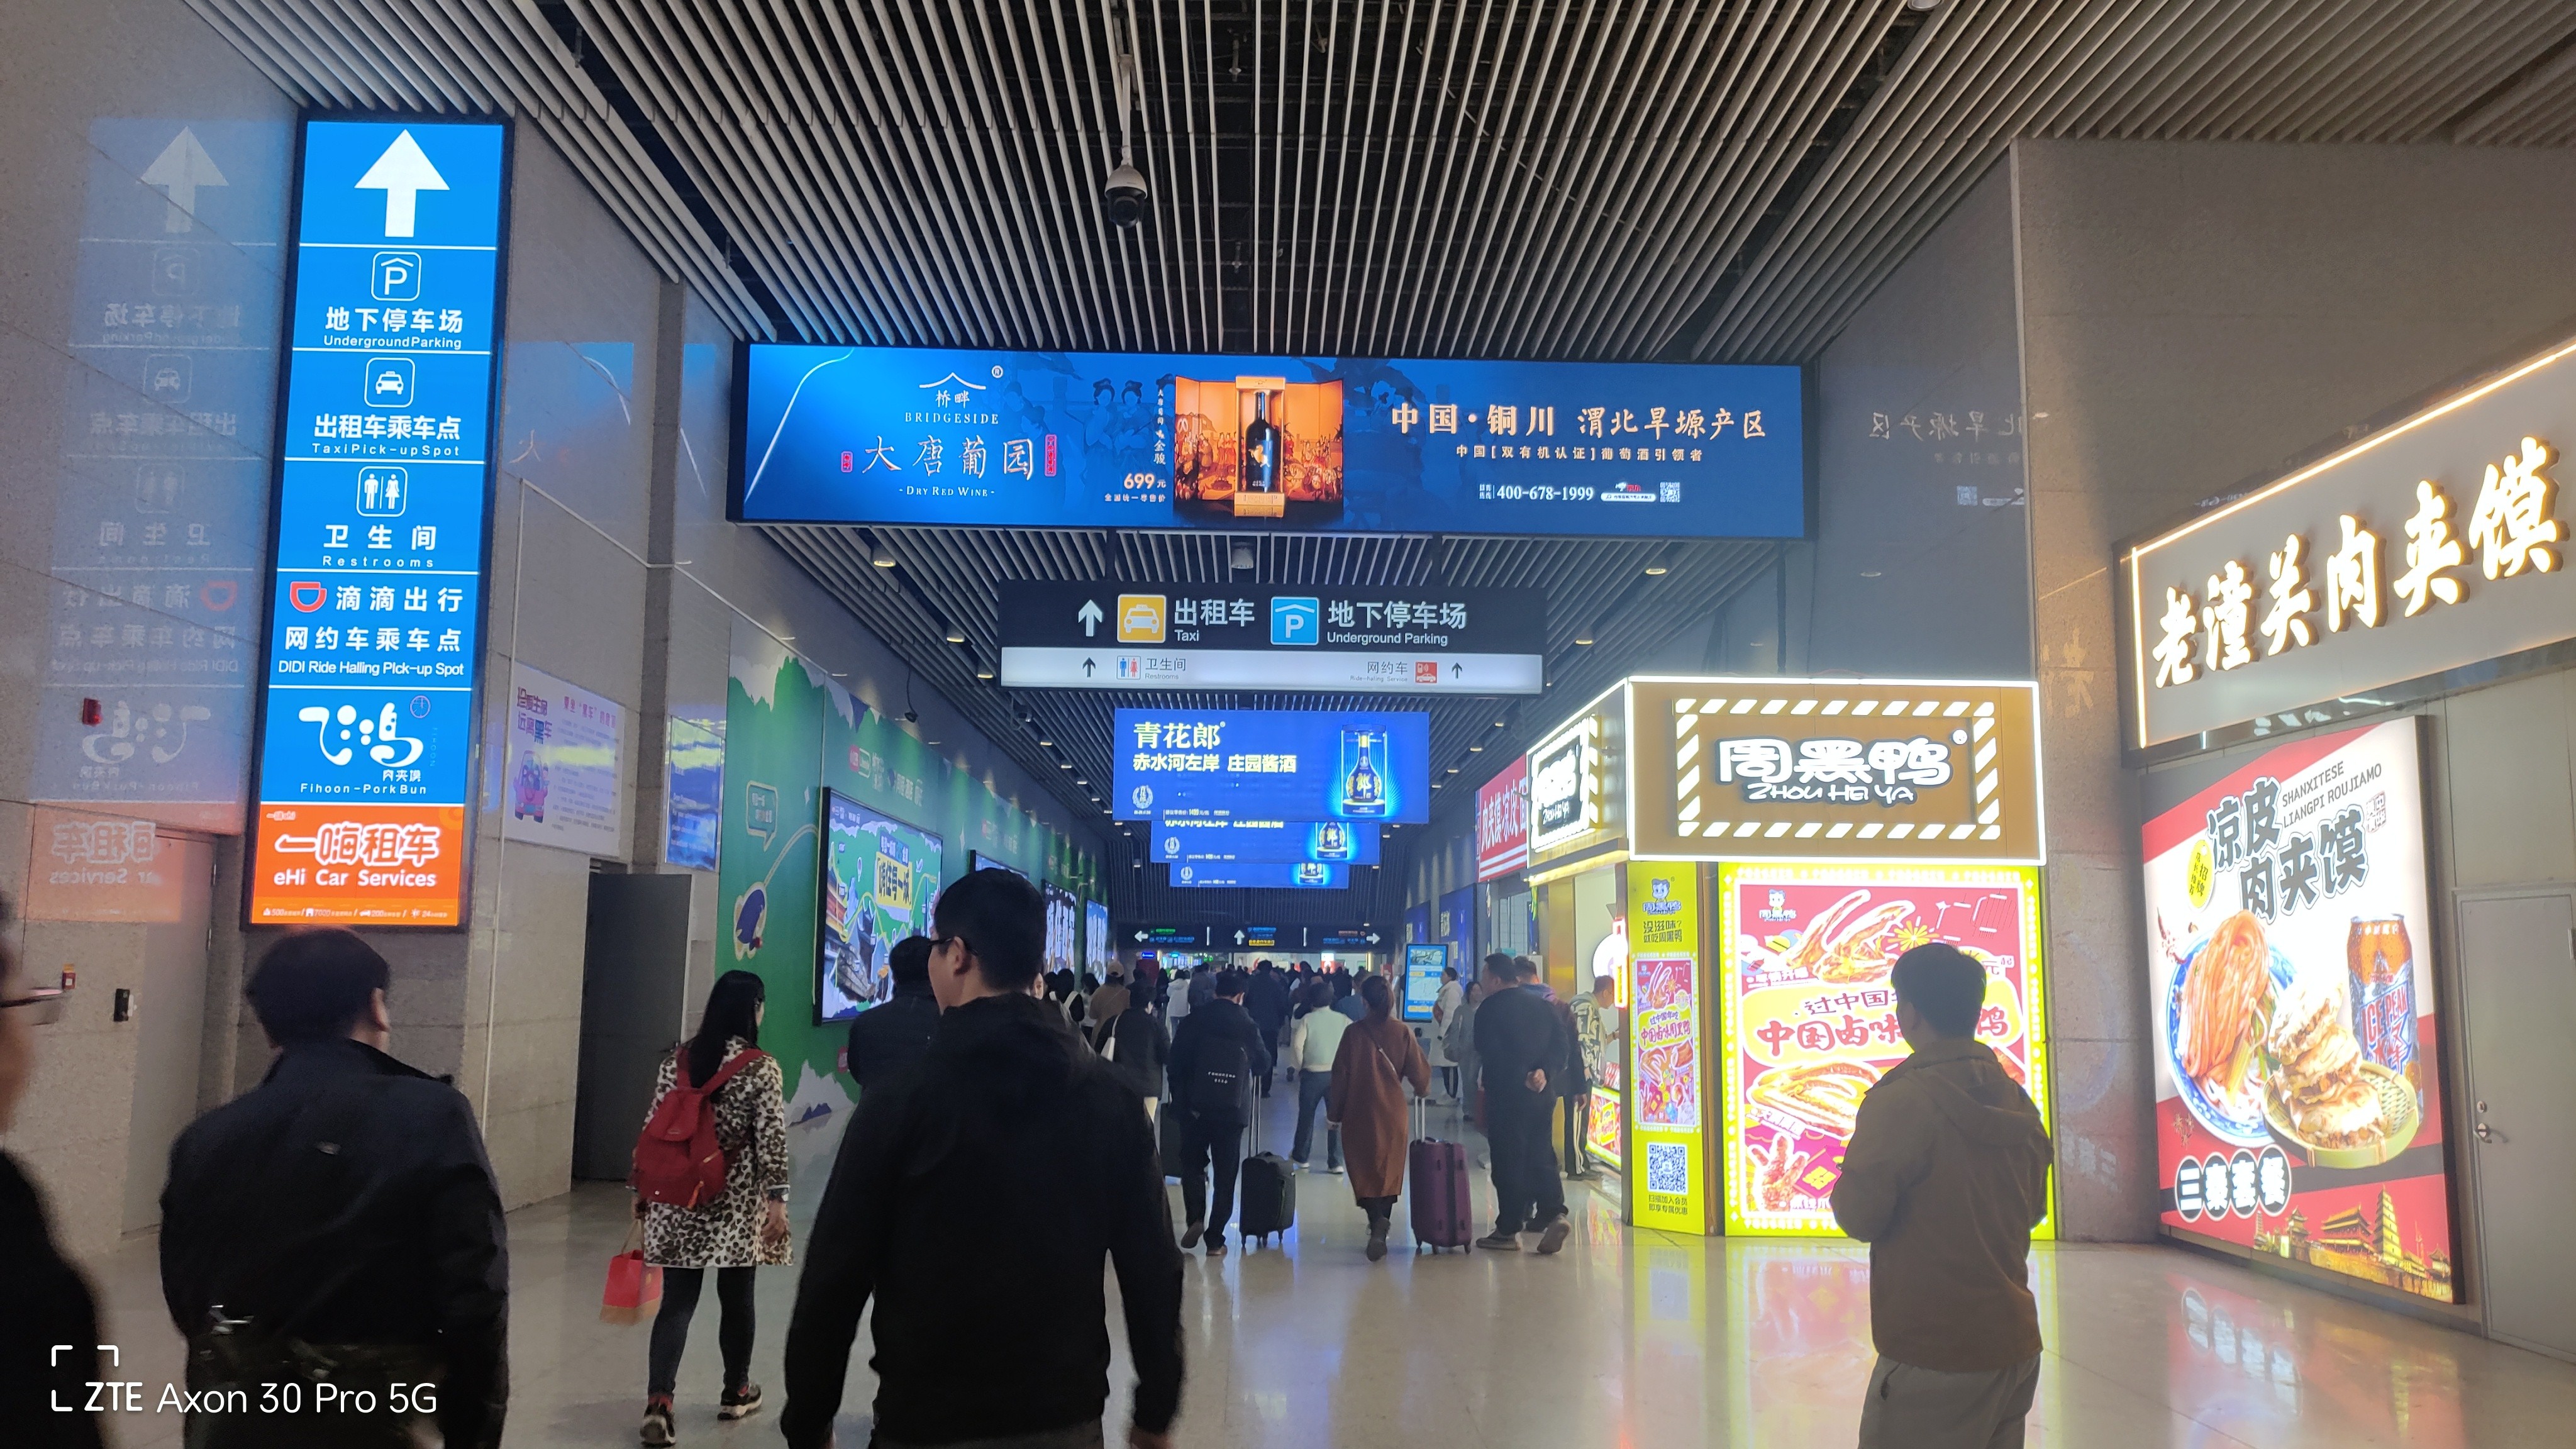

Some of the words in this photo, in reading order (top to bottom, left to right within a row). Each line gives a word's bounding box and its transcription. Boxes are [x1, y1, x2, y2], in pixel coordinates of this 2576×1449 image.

[325, 306, 463, 333] 地下停车场
[935, 390, 970, 409] 桥畔
[314, 413, 462, 440] 出租车乘车点
[905, 412, 999, 425] BRIDGESIDE
[1577, 407, 1767, 440] 渭北旱塬产区
[862, 435, 1033, 480] 大唐葡园
[1497, 486, 1593, 501] 400-678-1999
[323, 524, 436, 551] 卫生间
[323, 555, 434, 567] Restrooms
[2152, 436, 2558, 689] 老潼关肉夹馍
[336, 586, 463, 613] 滴滴出行
[1175, 599, 1255, 626] 出租车
[1328, 601, 1467, 630] 地下停车场
[286, 626, 461, 652] 网约车乘车点
[1174, 630, 1199, 641] Taxi
[1328, 631, 1402, 644] Underground
[1405, 633, 1448, 646] Parking
[279, 660, 305, 673] DIDI
[308, 660, 336, 674] Ride
[435, 662, 464, 677] Spot
[1145, 657, 1186, 672] 卫生间
[1367, 661, 1407, 675] 网约车
[1134, 722, 1220, 750] 青花郎
[1133, 753, 1219, 772] 赤水河左岸
[1228, 753, 1296, 774] 庄园酱酒
[1719, 738, 1951, 786] 周黑鸭
[1746, 782, 1823, 802] ZHOU
[1875, 786, 1914, 806] YA
[2282, 761, 2344, 807] SHANXITESE
[2284, 797, 2324, 828] LIANGPI
[2328, 763, 2382, 804] ROUJIAMO
[2208, 780, 2280, 870] 凉皮
[274, 821, 440, 867] 一嗨租车
[274, 869, 306, 886] eHi
[316, 869, 348, 886] Car
[358, 870, 437, 887] Services
[2240, 809, 2366, 920] 肉夹馍
[1804, 991, 1898, 1014] 过中国
[2361, 1000, 2384, 1052] ICE
[2385, 988, 2408, 1026] PEAK
